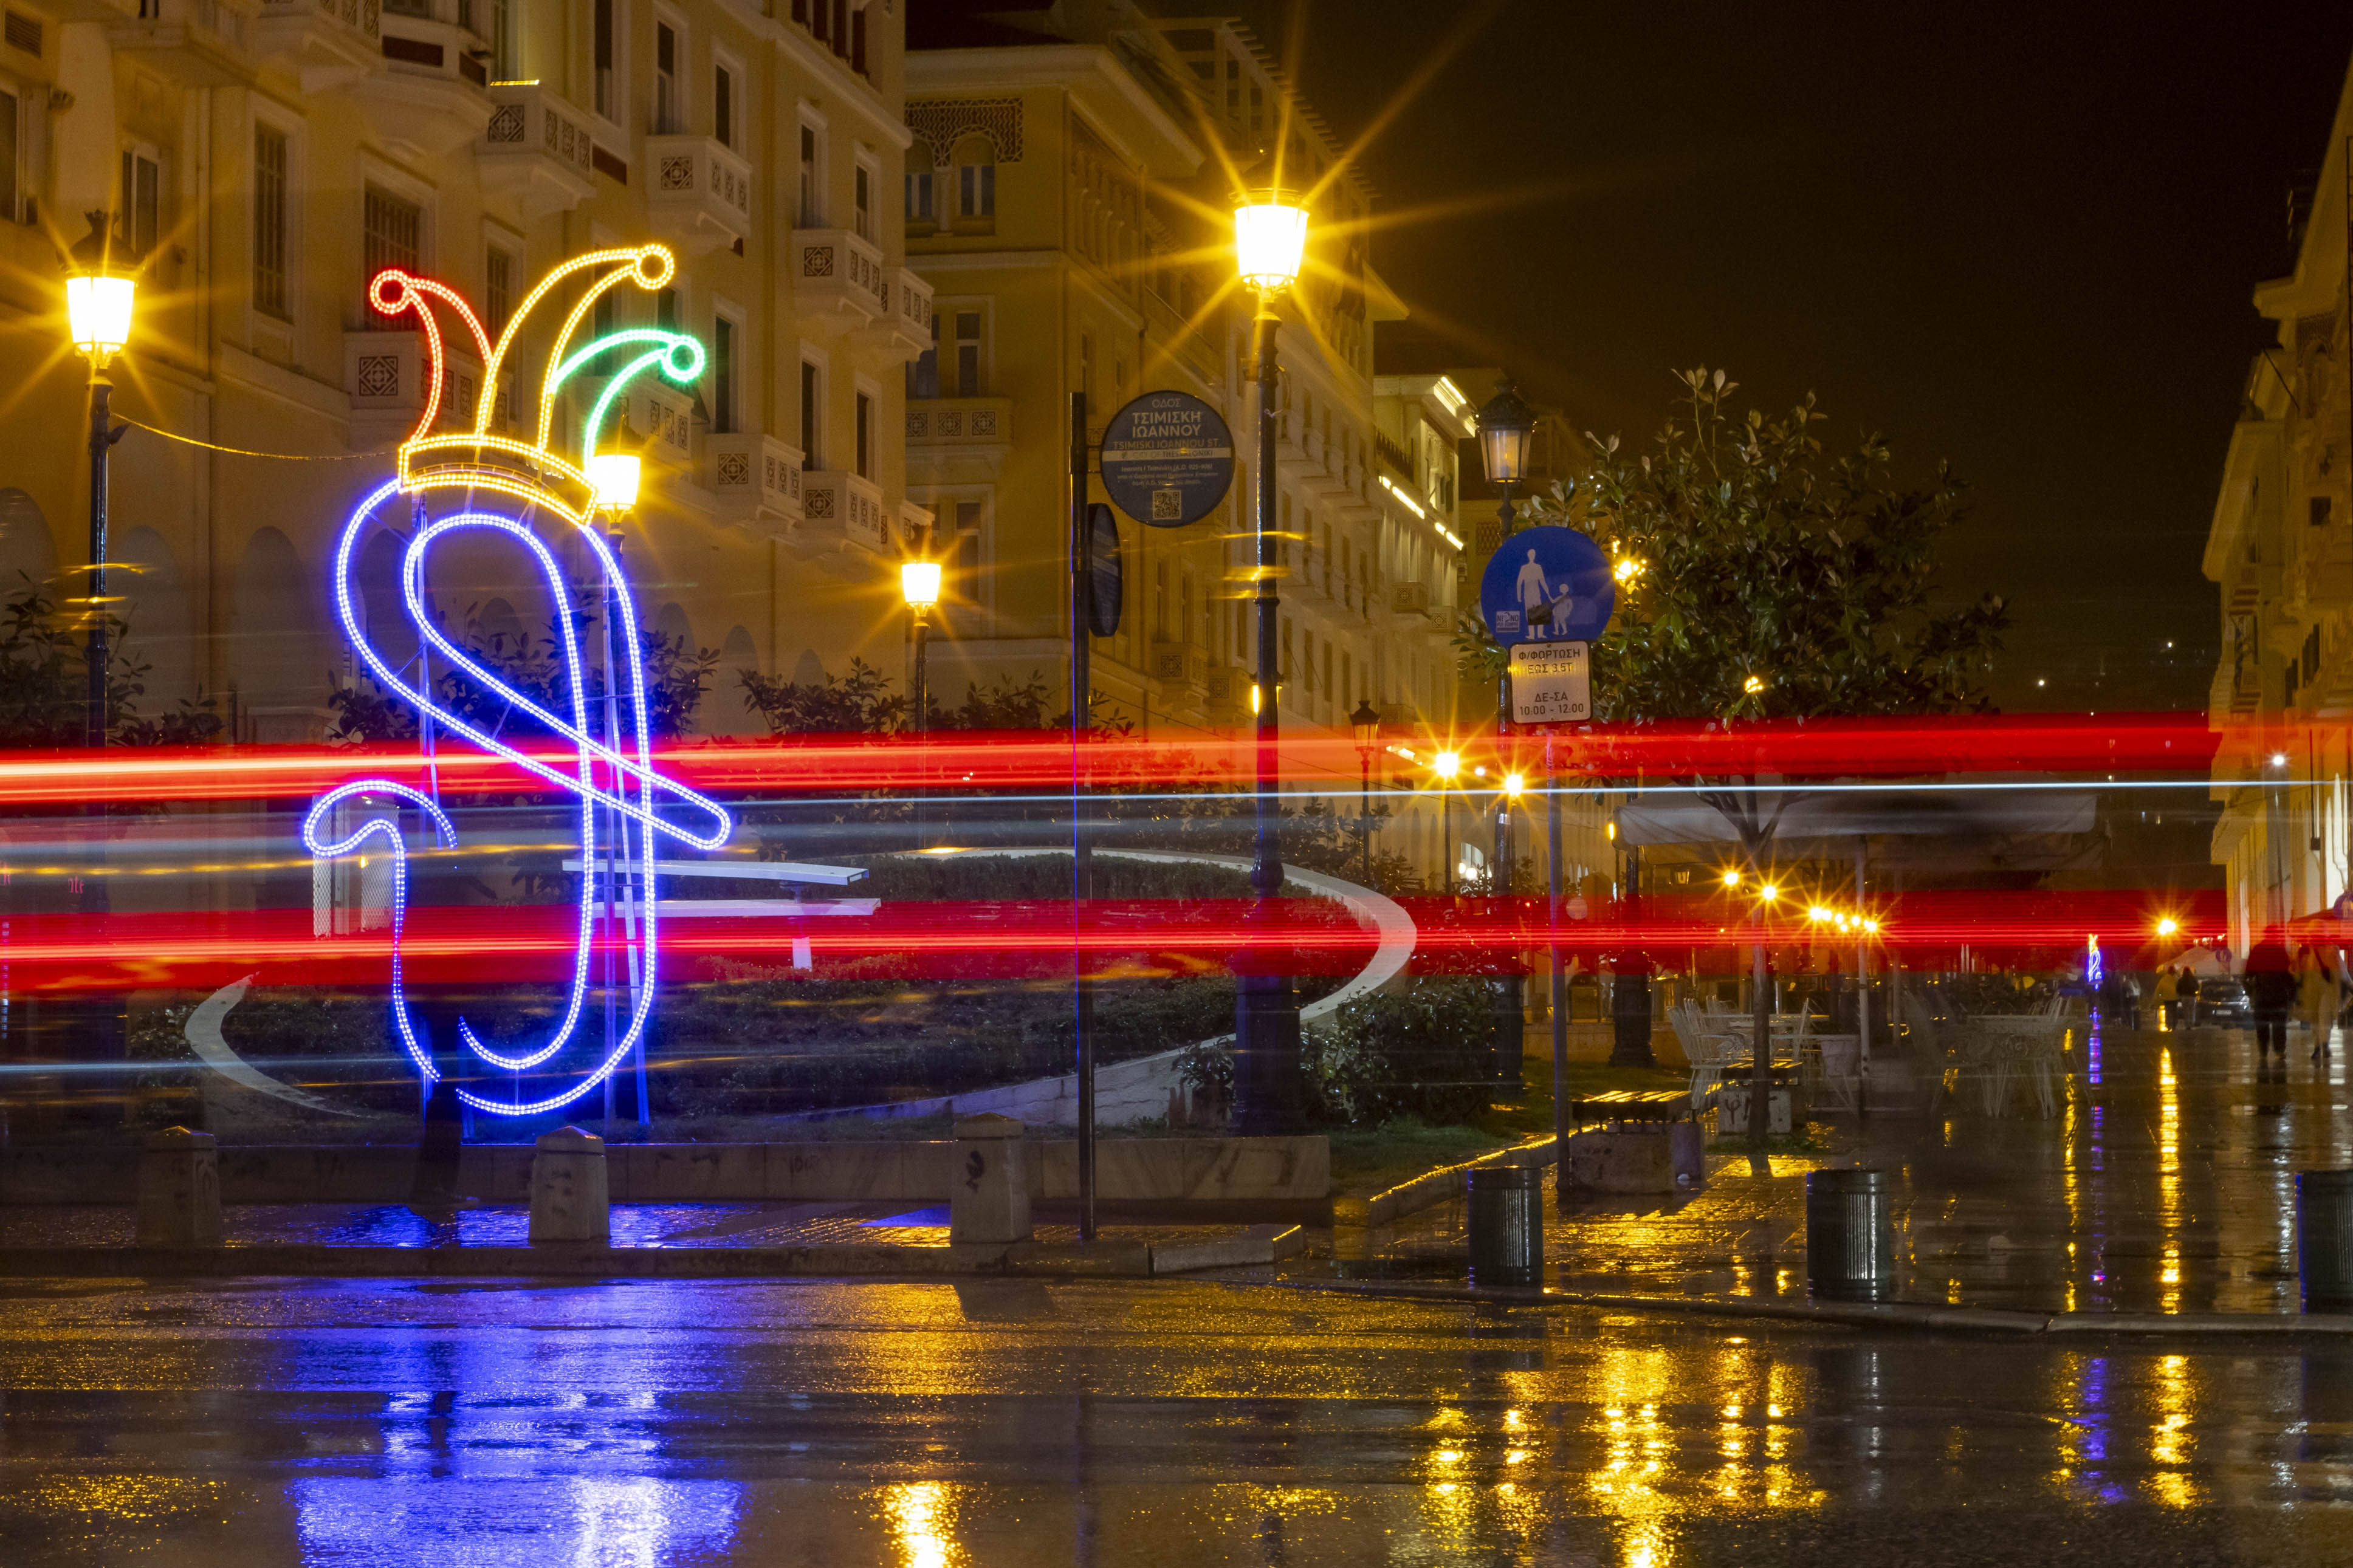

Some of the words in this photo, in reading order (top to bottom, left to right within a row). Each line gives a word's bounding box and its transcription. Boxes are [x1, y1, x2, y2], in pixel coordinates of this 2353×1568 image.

[1152, 398, 1181, 409] ΟΔΟΣ
[1132, 411, 1201, 425] ΤΣΙΜΙΣΚΗ
[1132, 425, 1201, 438] ΙΩΑΝΝΟΥ
[1113, 440, 1154, 450] TSIMISKI
[1157, 438, 1204, 449] IOANNOU
[1519, 648, 1580, 660] Φ/ΦΟΡΤΩΣΗ
[1528, 663, 1549, 674] ΕΩΣ
[1535, 691, 1568, 702] ΔΕ-ΣΑ
[1520, 705, 1545, 716] 10:00
[1558, 704, 1584, 714] 12:00
